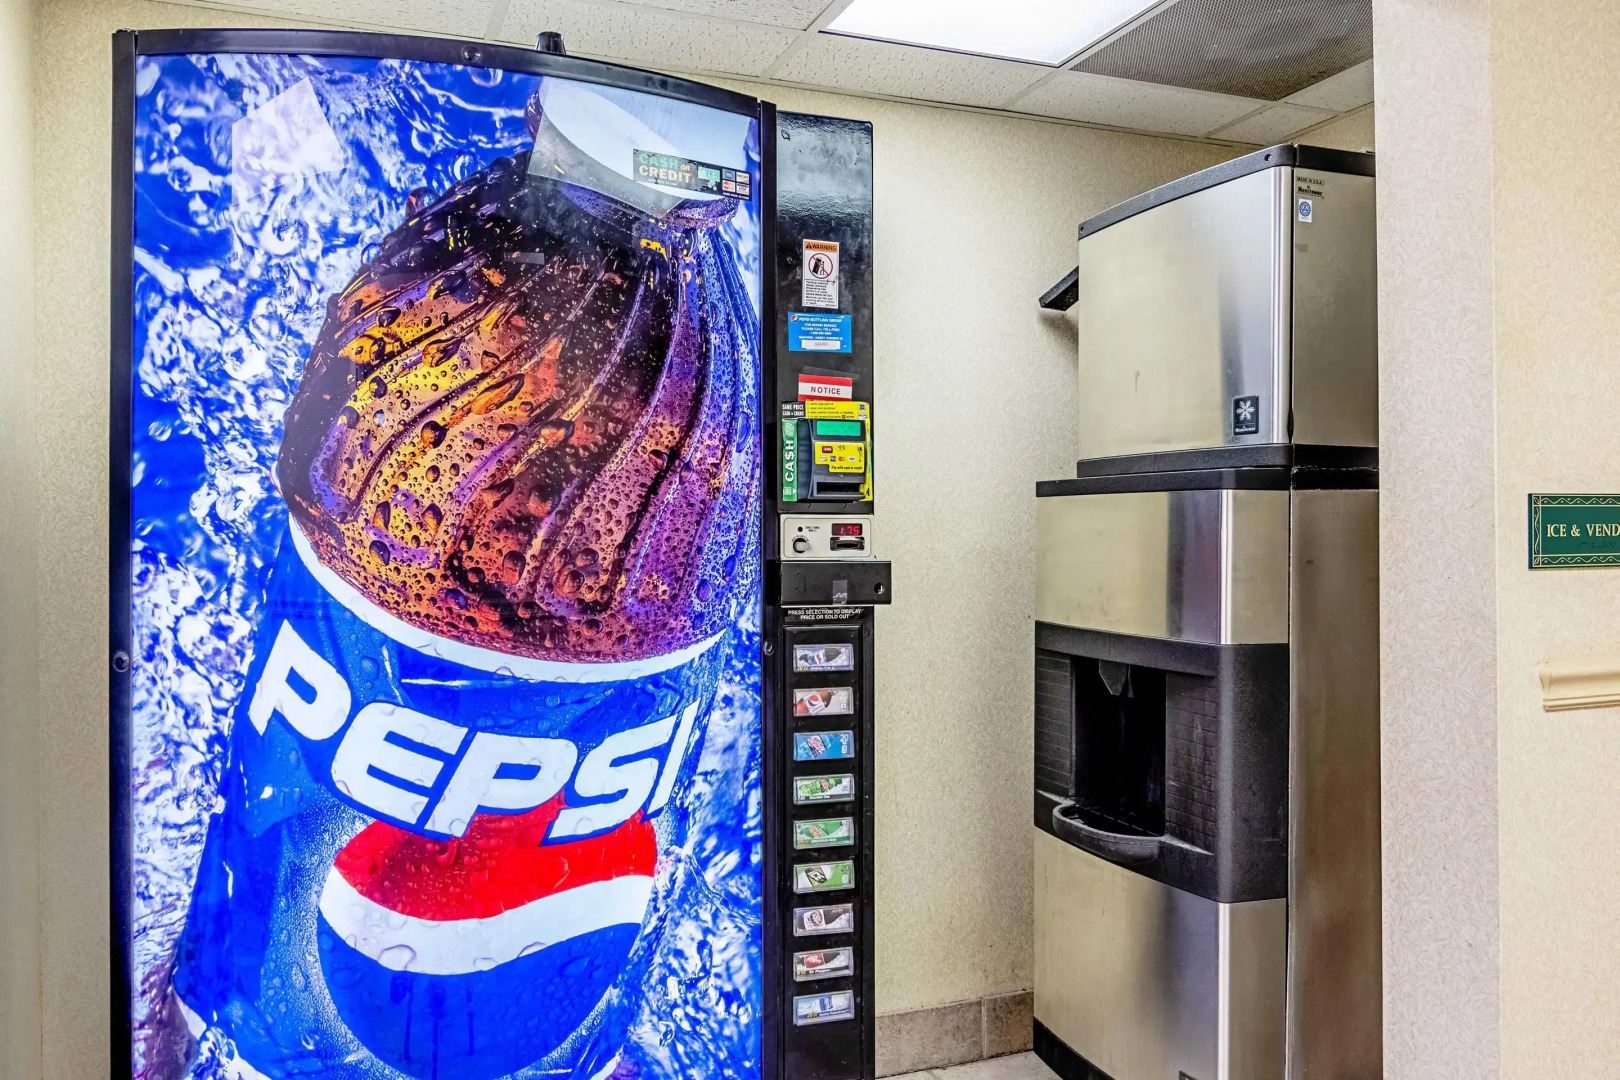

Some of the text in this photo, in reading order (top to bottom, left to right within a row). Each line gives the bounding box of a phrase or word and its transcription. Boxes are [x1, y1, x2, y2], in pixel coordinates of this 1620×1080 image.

[639, 153, 678, 168] CASH
[639, 165, 692, 184] CREDIT
[812, 243, 837, 251] WARNING
[810, 386, 841, 395] NOTICE
[784, 440, 795, 482] CASH
[1546, 524, 1567, 537] ICE
[1570, 524, 1581, 537] &
[248, 619, 700, 838] PEPSI
[840, 734, 849, 742] 20
